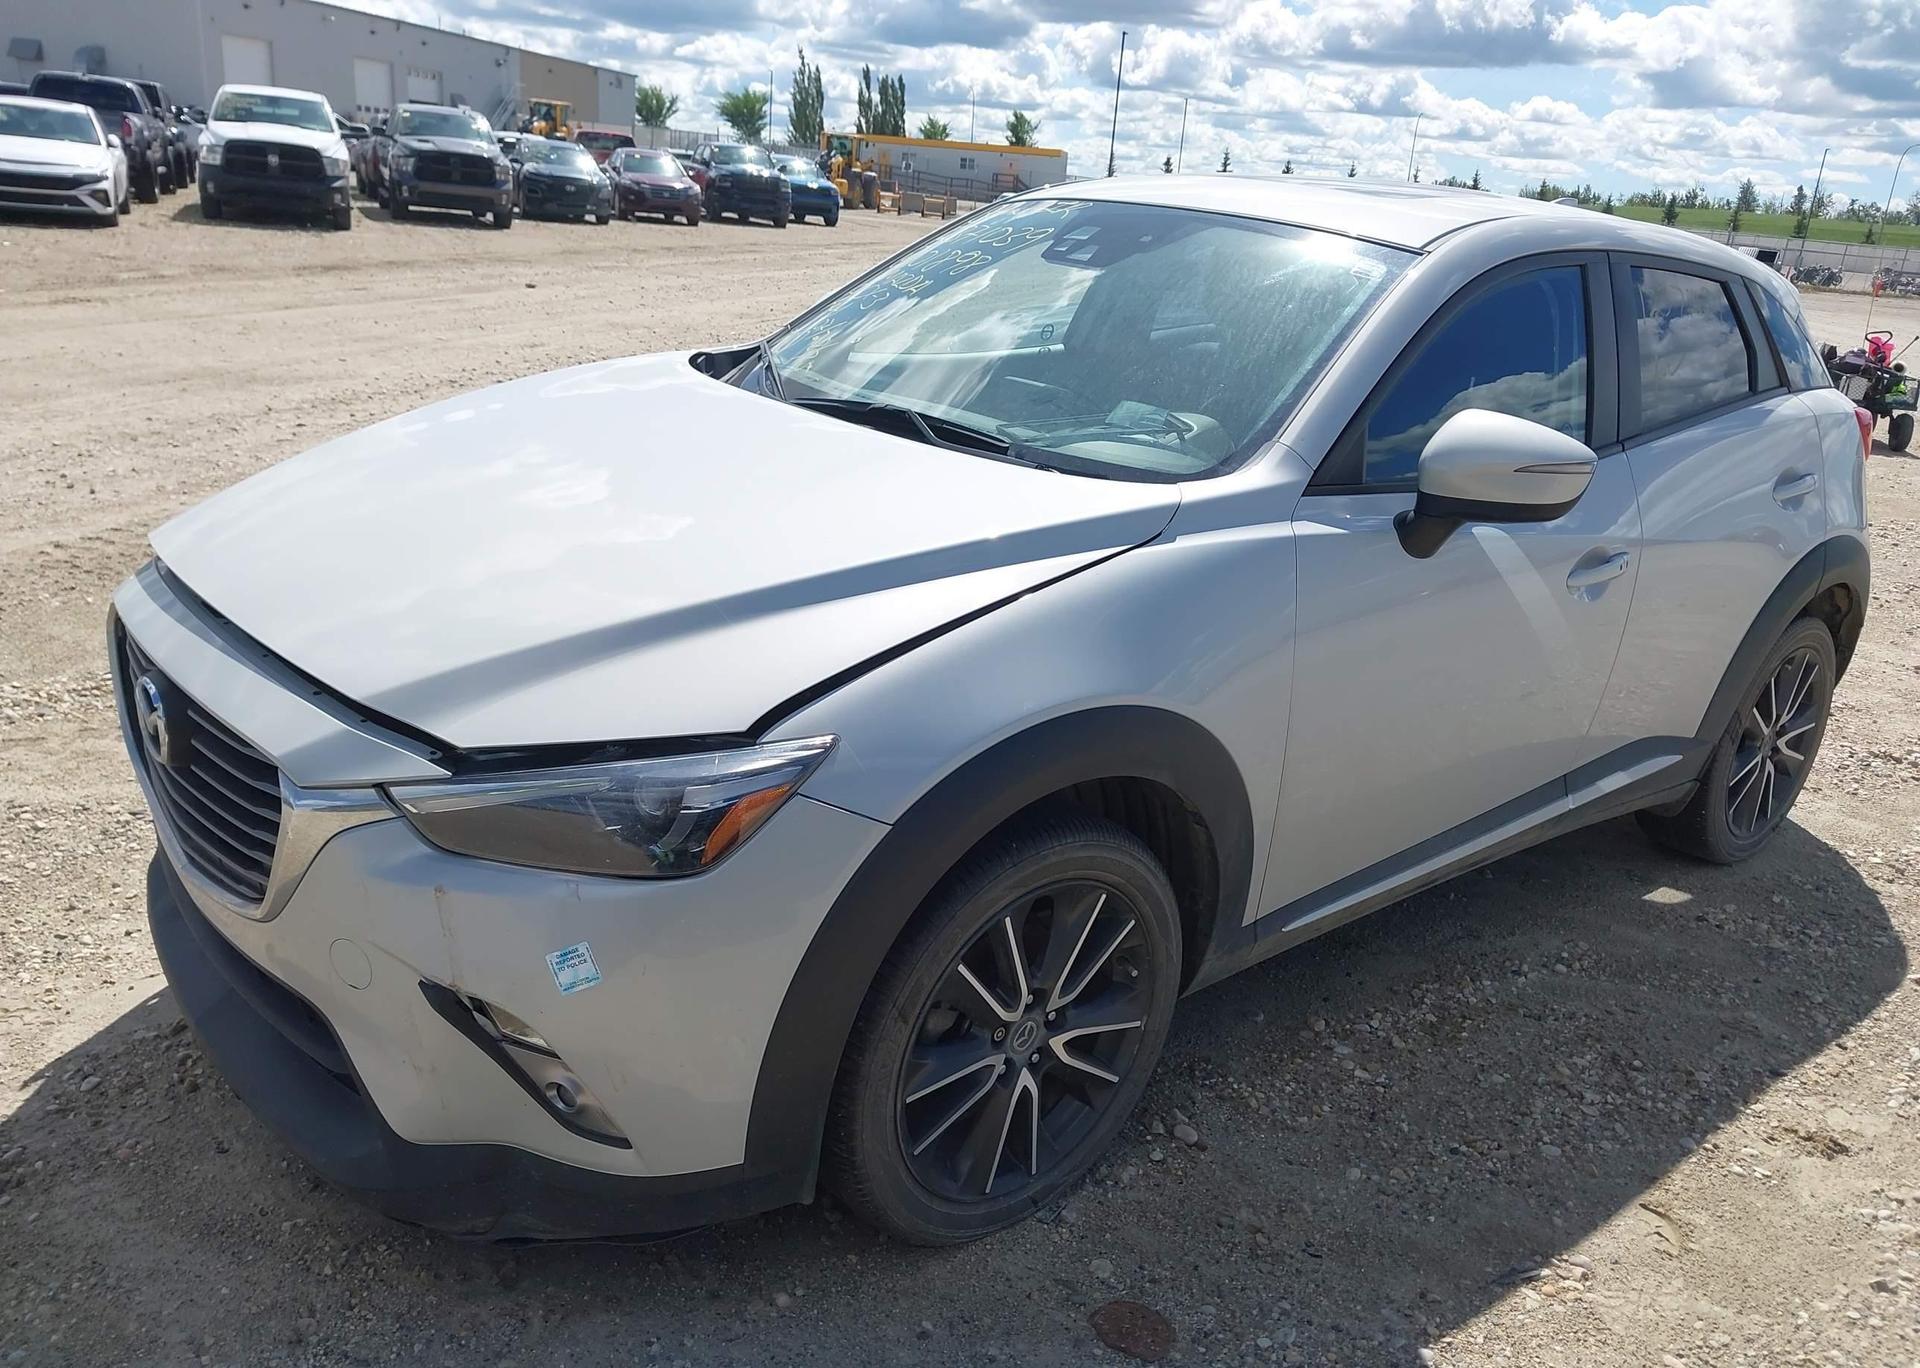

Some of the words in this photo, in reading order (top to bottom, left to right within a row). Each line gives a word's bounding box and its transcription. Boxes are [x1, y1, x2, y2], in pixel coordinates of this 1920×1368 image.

[555, 952, 586, 966] REPORTED
[556, 947, 579, 959] DAMAGE
[567, 958, 588, 969] POLICE
